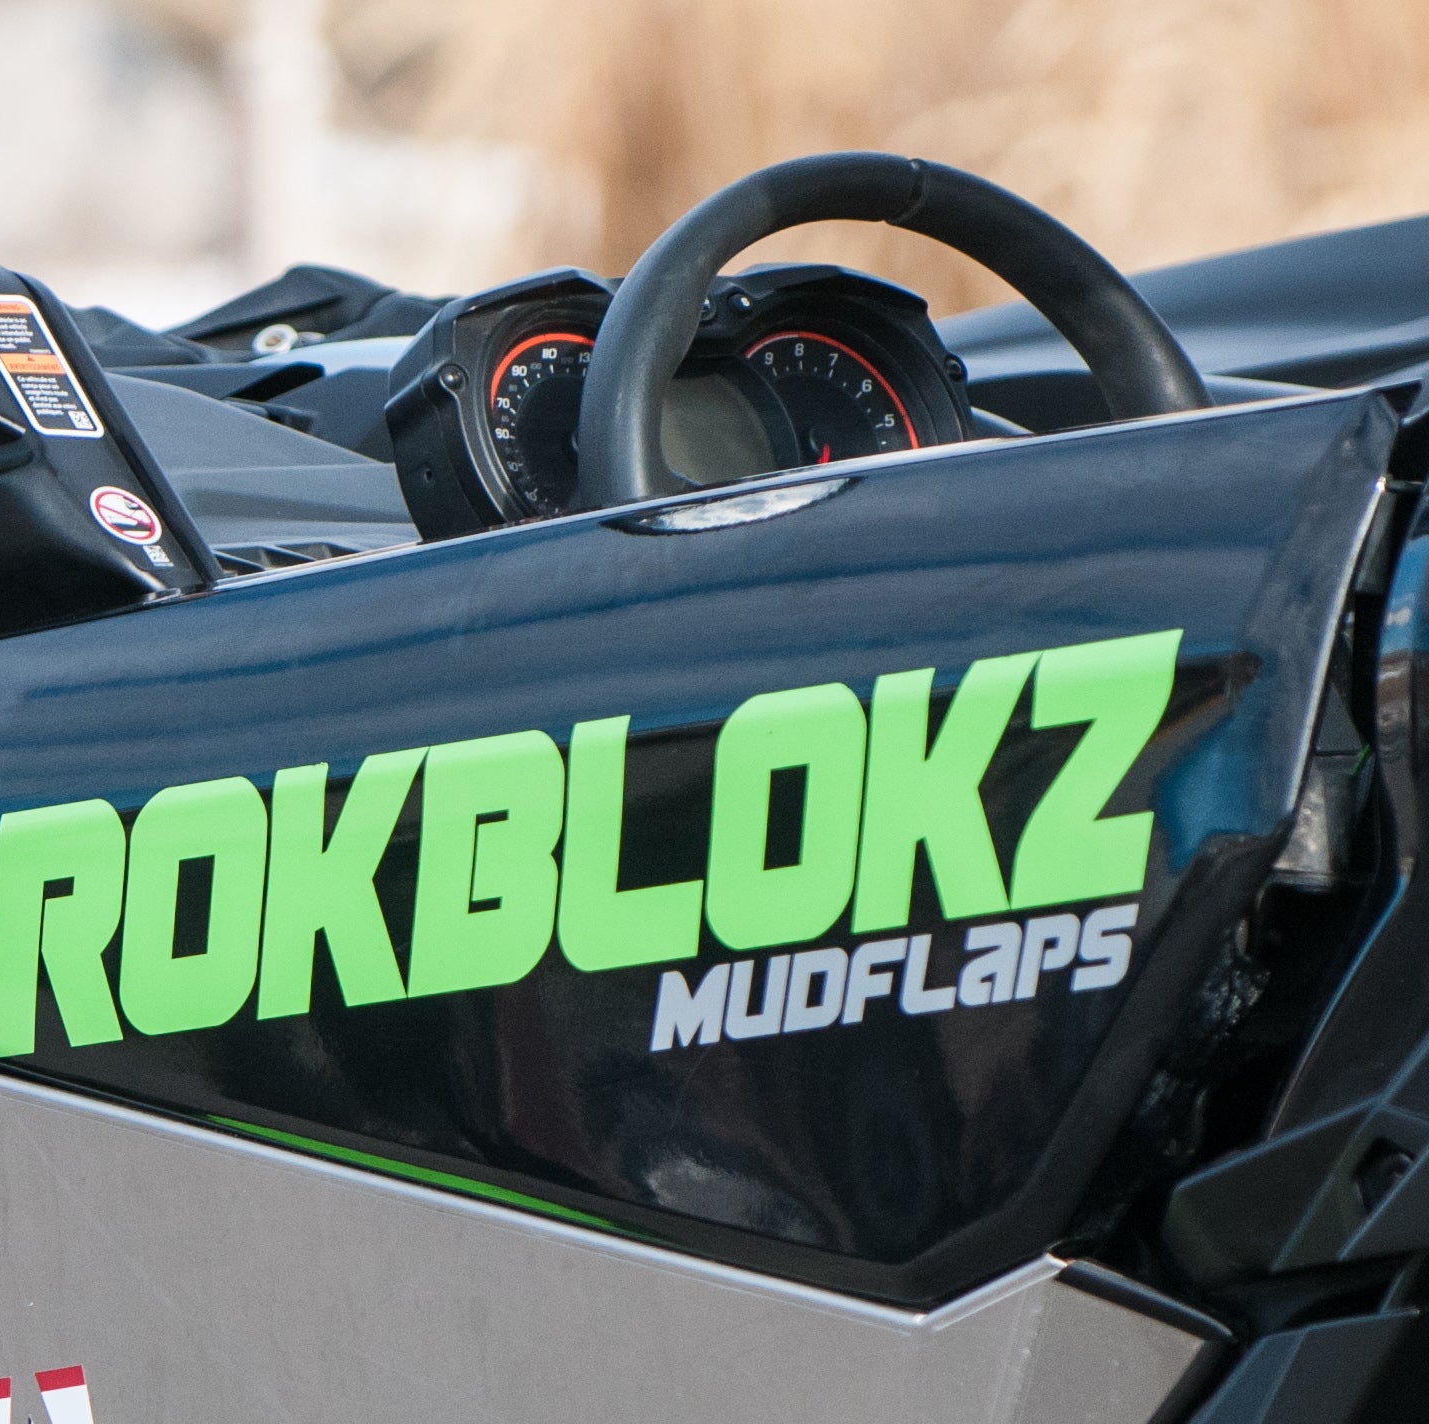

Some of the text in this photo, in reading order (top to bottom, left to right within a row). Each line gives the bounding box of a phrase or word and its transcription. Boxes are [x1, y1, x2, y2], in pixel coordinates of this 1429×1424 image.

[542, 348, 557, 359] 110
[794, 343, 804, 357] 8
[579, 352, 590, 363] 13
[764, 352, 774, 365] 9
[828, 353, 839, 366] 7
[511, 365, 527, 377] 90
[861, 379, 872, 393] 6
[496, 397, 510, 409] 70
[884, 413, 896, 427] 5
